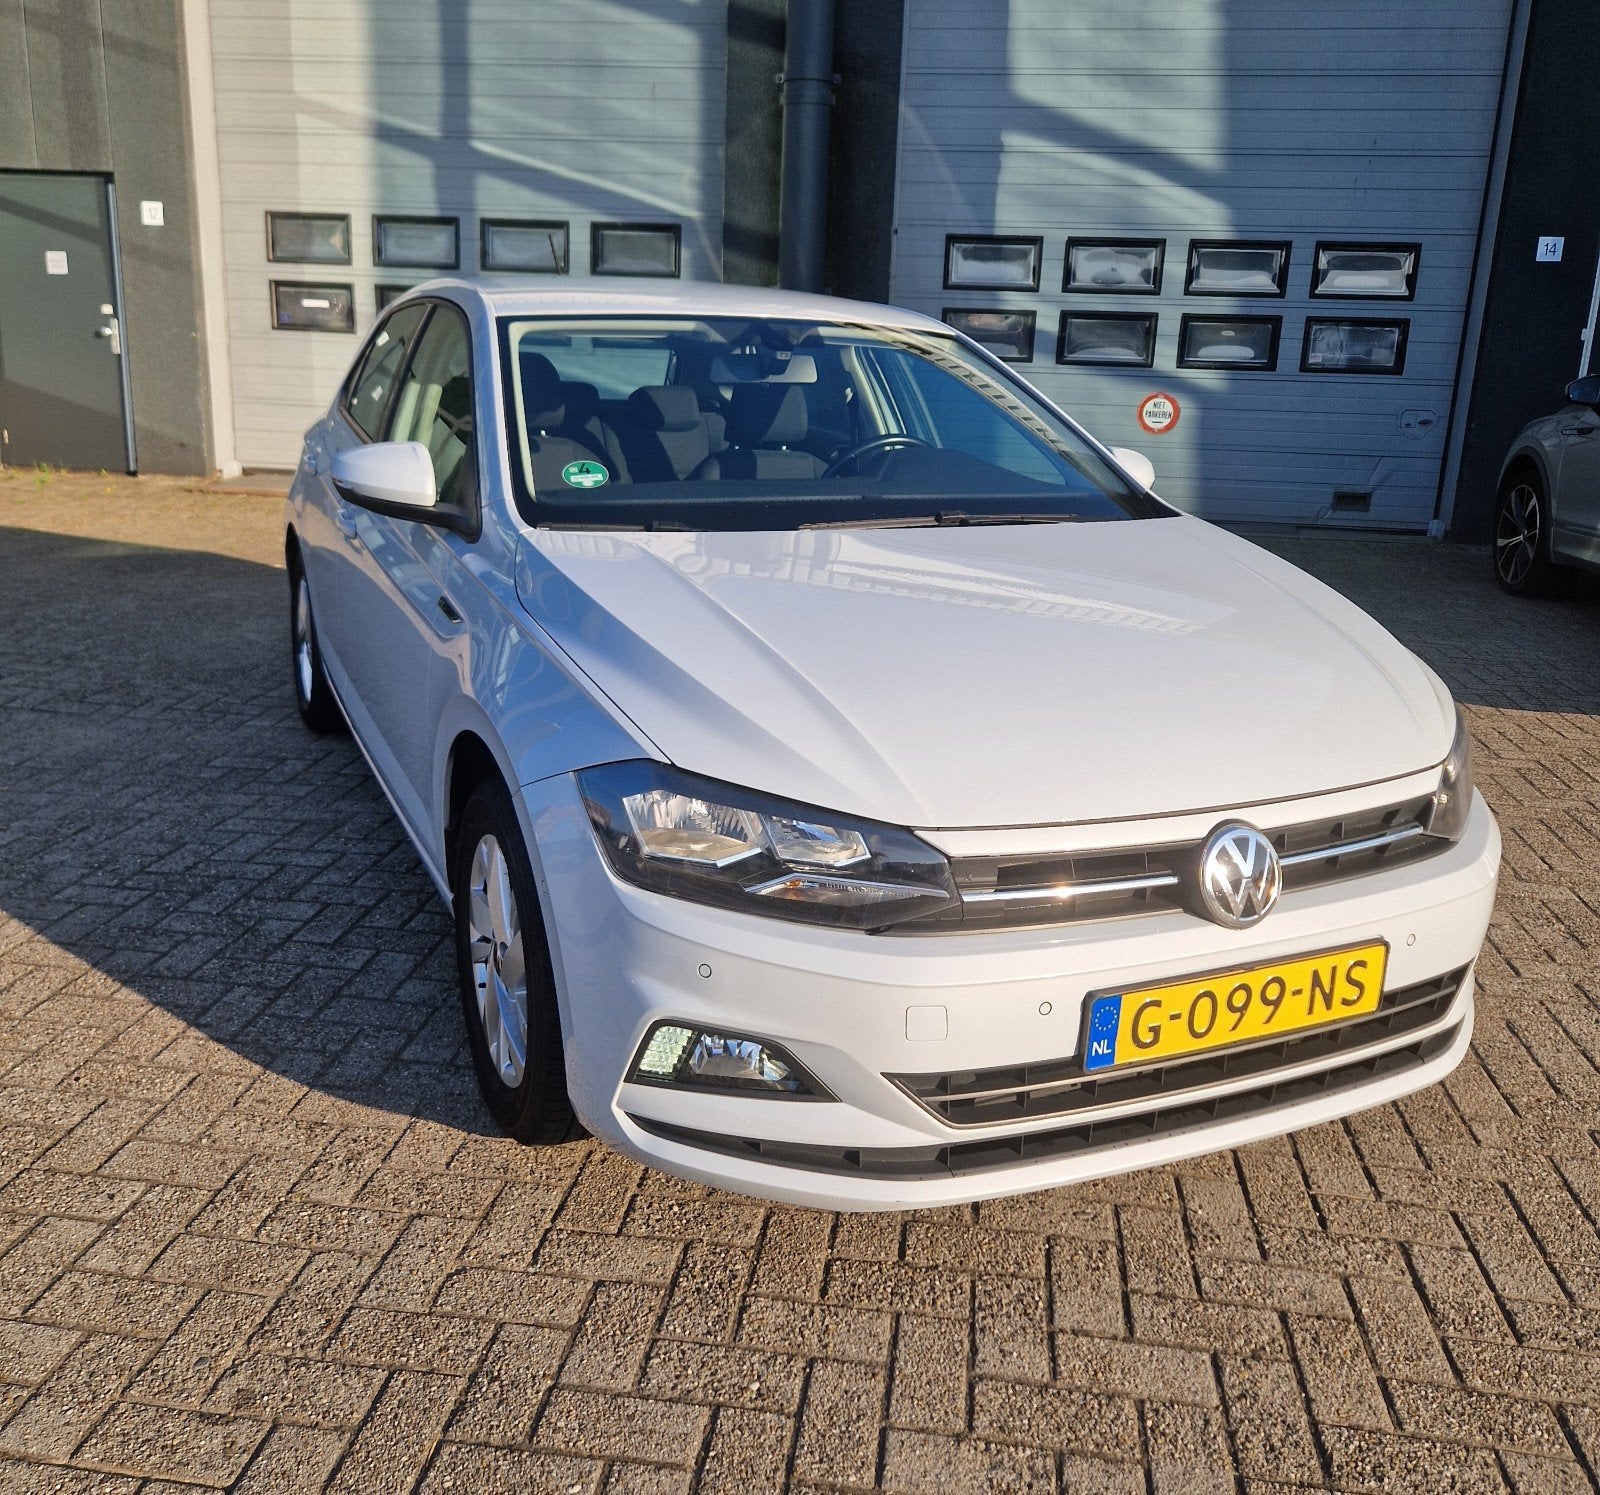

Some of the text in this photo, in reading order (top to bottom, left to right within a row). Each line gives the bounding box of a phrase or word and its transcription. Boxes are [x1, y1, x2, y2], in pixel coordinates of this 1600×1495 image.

[1543, 242, 1558, 256] 14
[1153, 401, 1166, 410] NIET
[1145, 410, 1172, 419] PARKEREN
[578, 462, 591, 475] 4
[1130, 959, 1368, 1050] G-099-NS
[1091, 1038, 1112, 1057] NL
